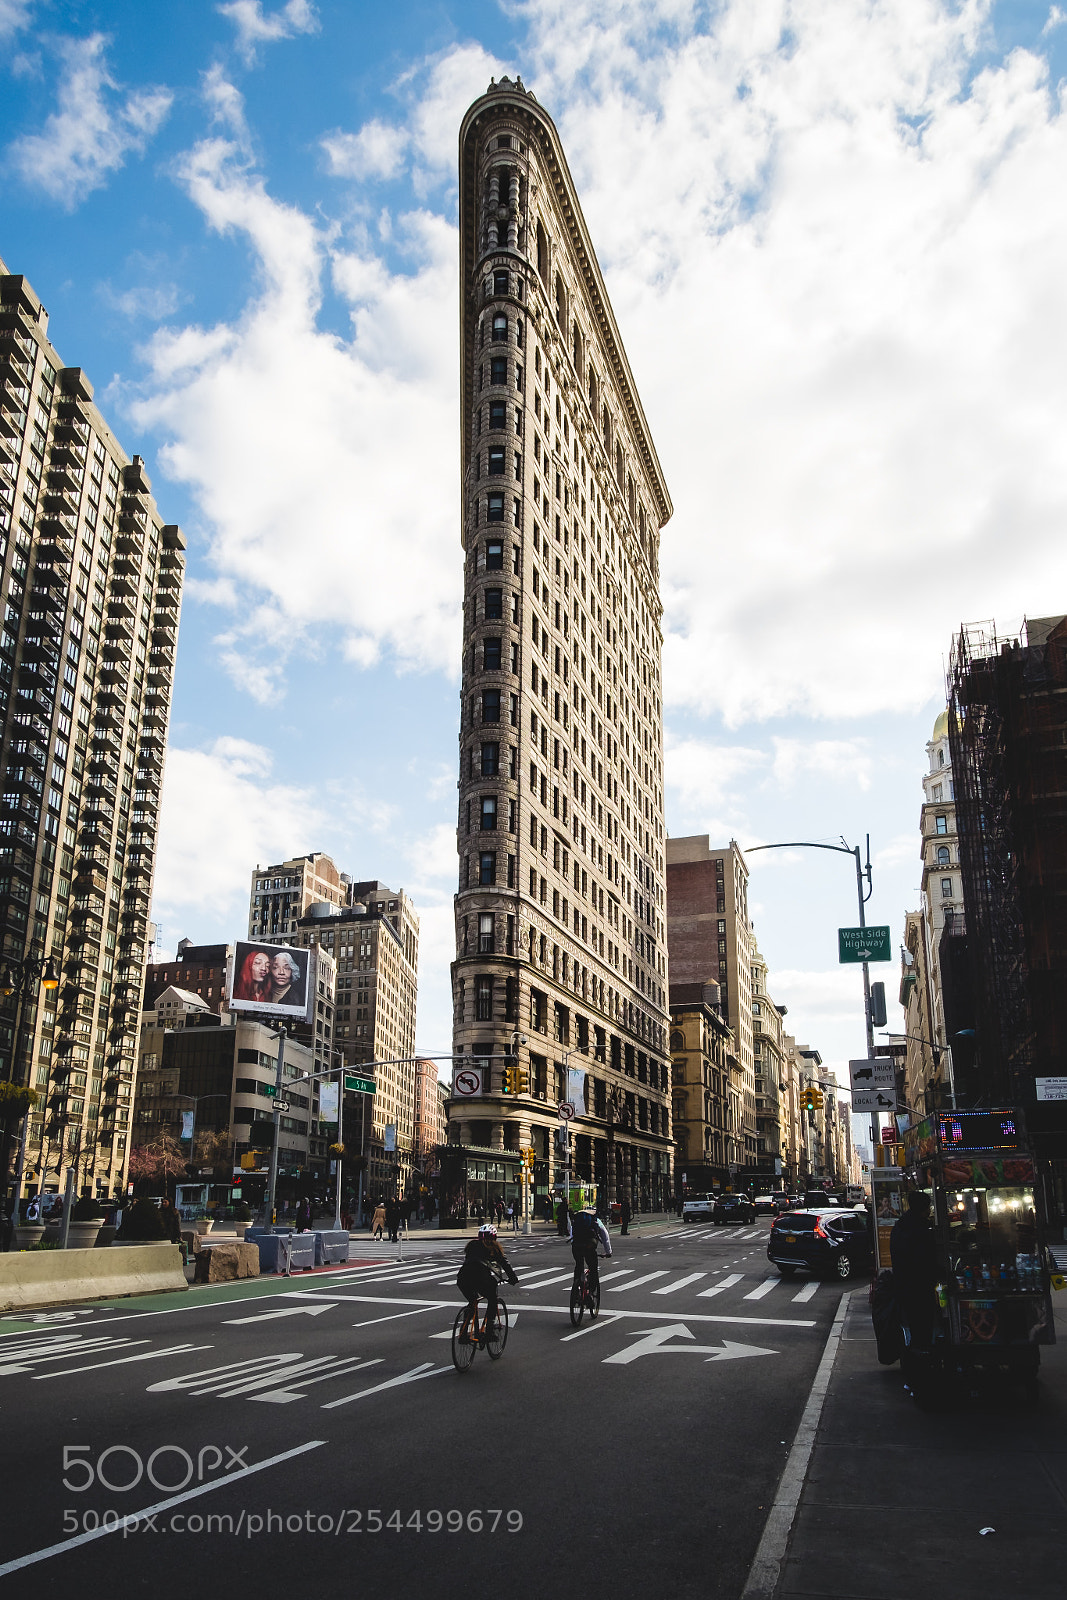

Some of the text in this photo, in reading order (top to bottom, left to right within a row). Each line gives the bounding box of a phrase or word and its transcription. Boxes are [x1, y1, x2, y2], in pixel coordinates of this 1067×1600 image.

[842, 929, 886, 939] West Side
[845, 939, 884, 950] Highway
[874, 1074, 893, 1082] ROUTE
[146, 1352, 455, 1409] ONLY
